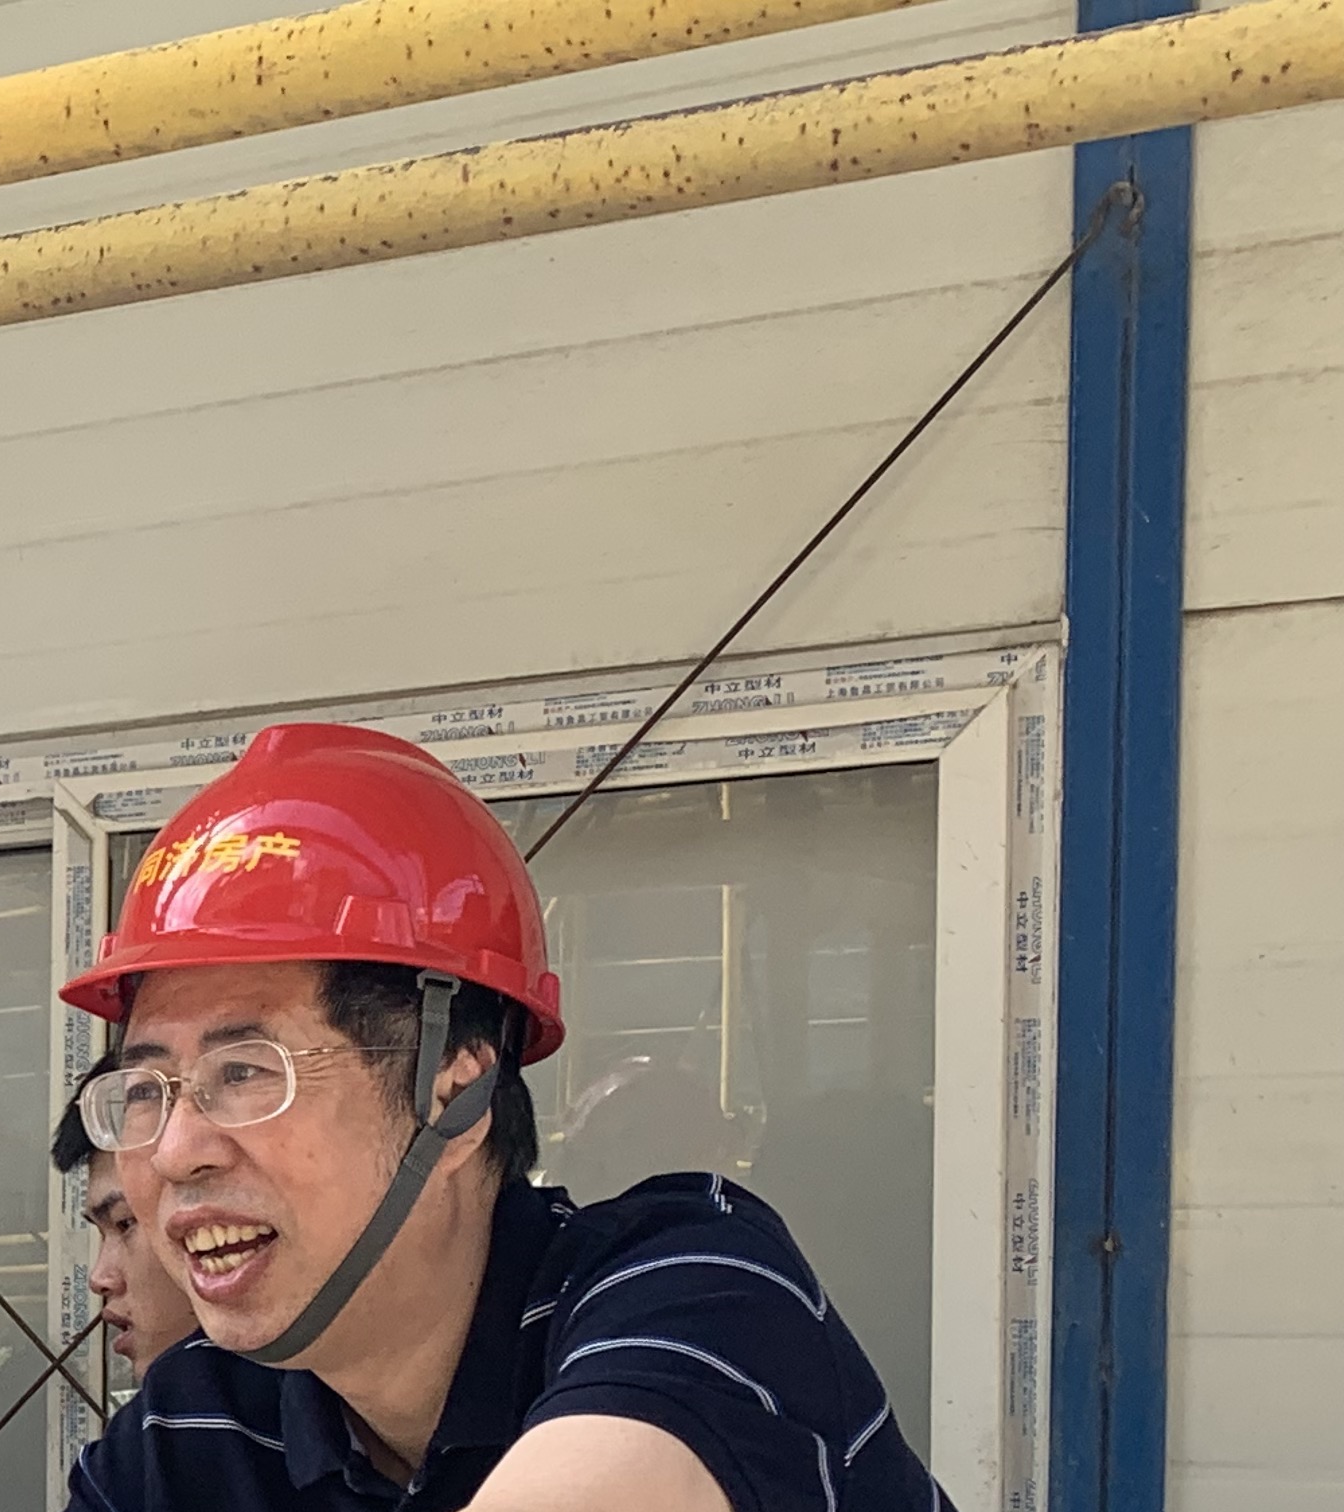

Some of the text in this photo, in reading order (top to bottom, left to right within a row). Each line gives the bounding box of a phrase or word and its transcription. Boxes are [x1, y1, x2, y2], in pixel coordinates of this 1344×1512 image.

[703, 675, 782, 695] 中立型材
[432, 703, 503, 724] 中立型材
[180, 734, 247, 752] 中立型材
[737, 743, 817, 760] 中立型材
[462, 768, 534, 787] 中立型材
[132, 831, 301, 895] 同济房产
[1015, 890, 1029, 973] 中立型材
[1011, 1192, 1025, 1274] 中立型材
